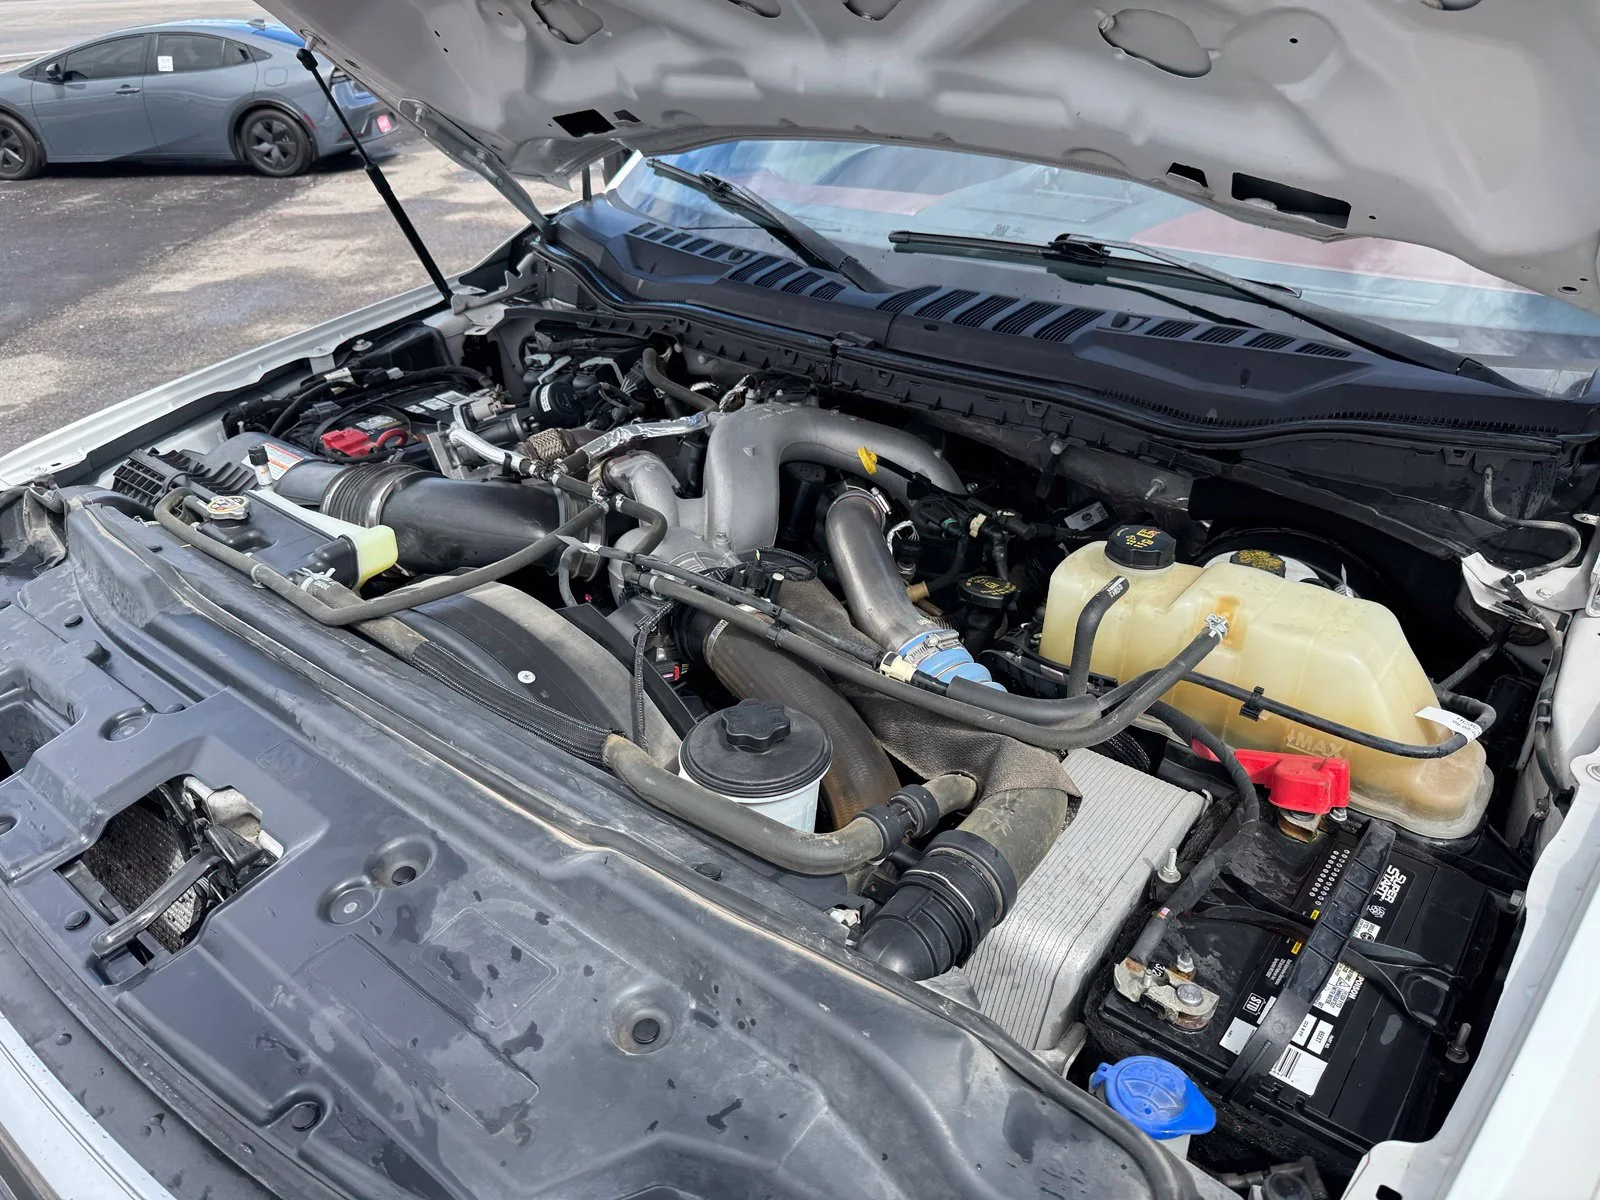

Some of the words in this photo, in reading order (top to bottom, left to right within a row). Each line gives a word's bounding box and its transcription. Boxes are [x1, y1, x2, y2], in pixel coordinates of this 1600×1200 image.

[1295, 732, 1344, 758] MAX
[1376, 864, 1400, 901] START
[1384, 874, 1407, 904] SUPER
[1348, 974, 1365, 1000] POISON
[1246, 996, 1262, 1011] STD
